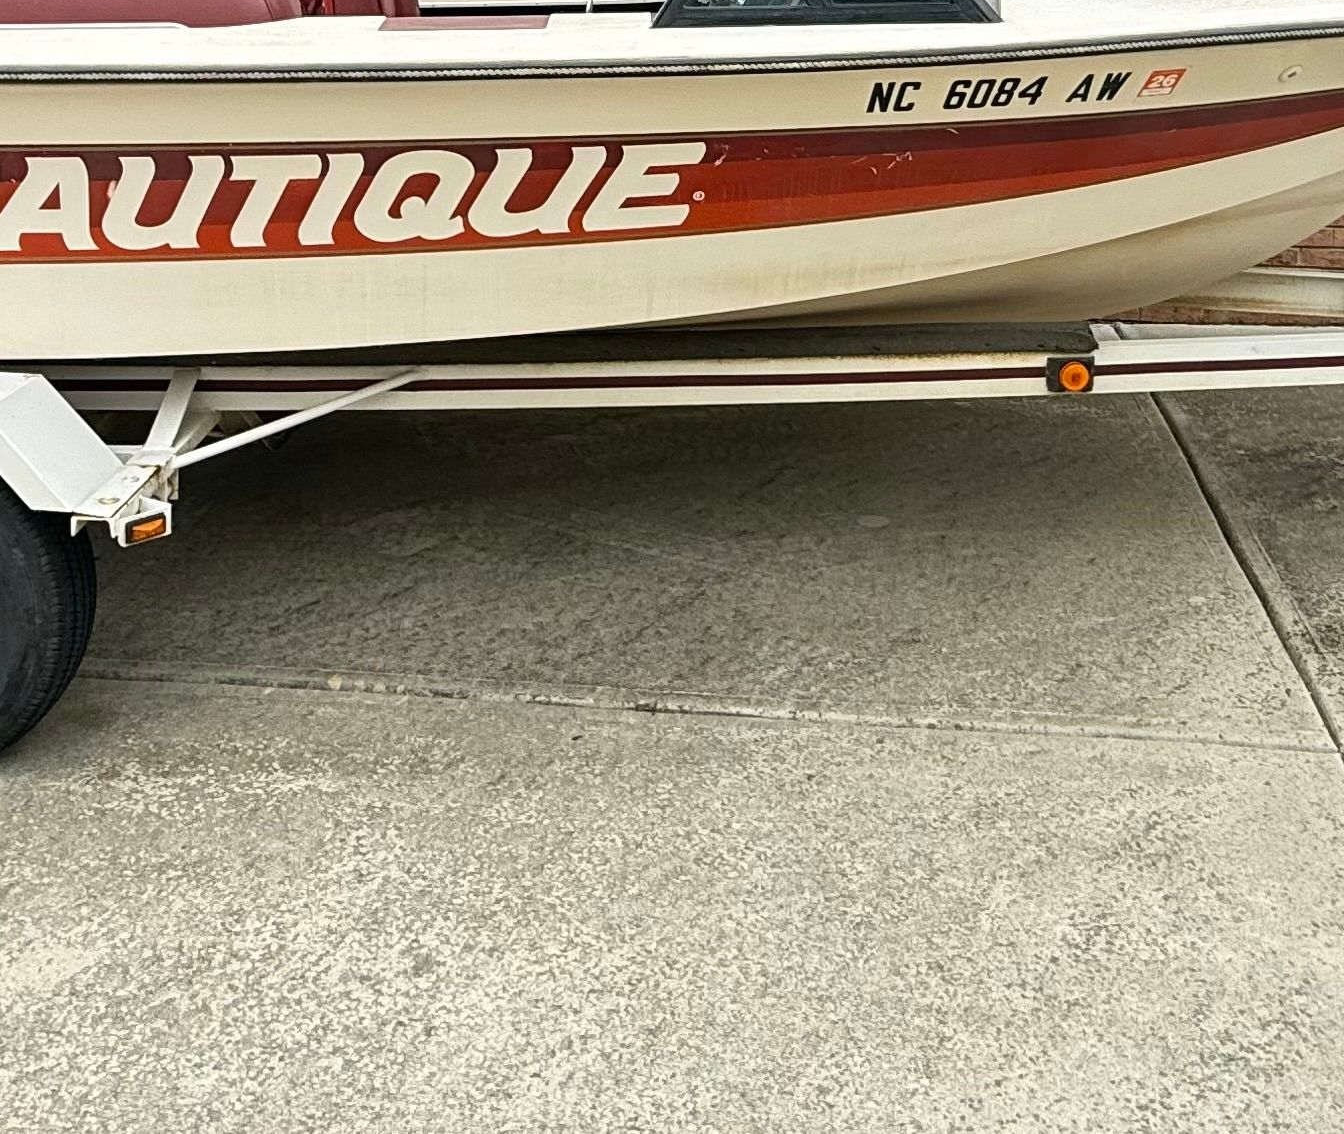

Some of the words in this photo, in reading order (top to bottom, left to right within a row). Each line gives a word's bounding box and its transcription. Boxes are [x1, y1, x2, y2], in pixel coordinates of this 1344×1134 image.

[866, 81, 922, 113] NC
[942, 75, 1049, 110] 6084
[1065, 71, 1133, 103] AW
[1148, 73, 1178, 88] 26
